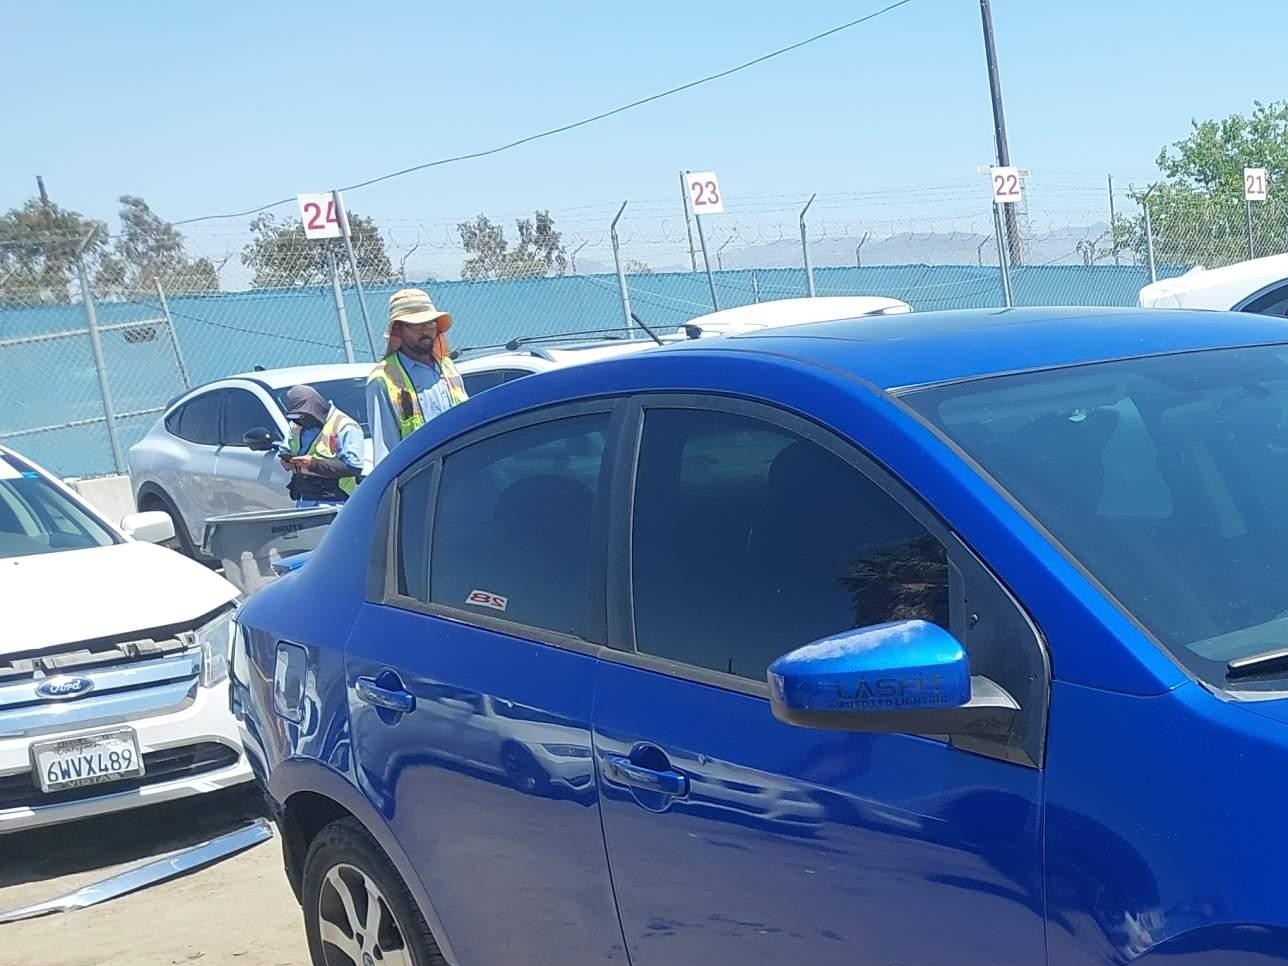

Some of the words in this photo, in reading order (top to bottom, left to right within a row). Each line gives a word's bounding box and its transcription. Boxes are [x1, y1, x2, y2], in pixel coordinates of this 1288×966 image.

[691, 180, 719, 206] 23
[994, 174, 1020, 196] 22
[1246, 174, 1265, 194] 21
[303, 200, 342, 230] 24
[49, 679, 82, 693] Ford
[47, 748, 133, 783] 6WVX489
